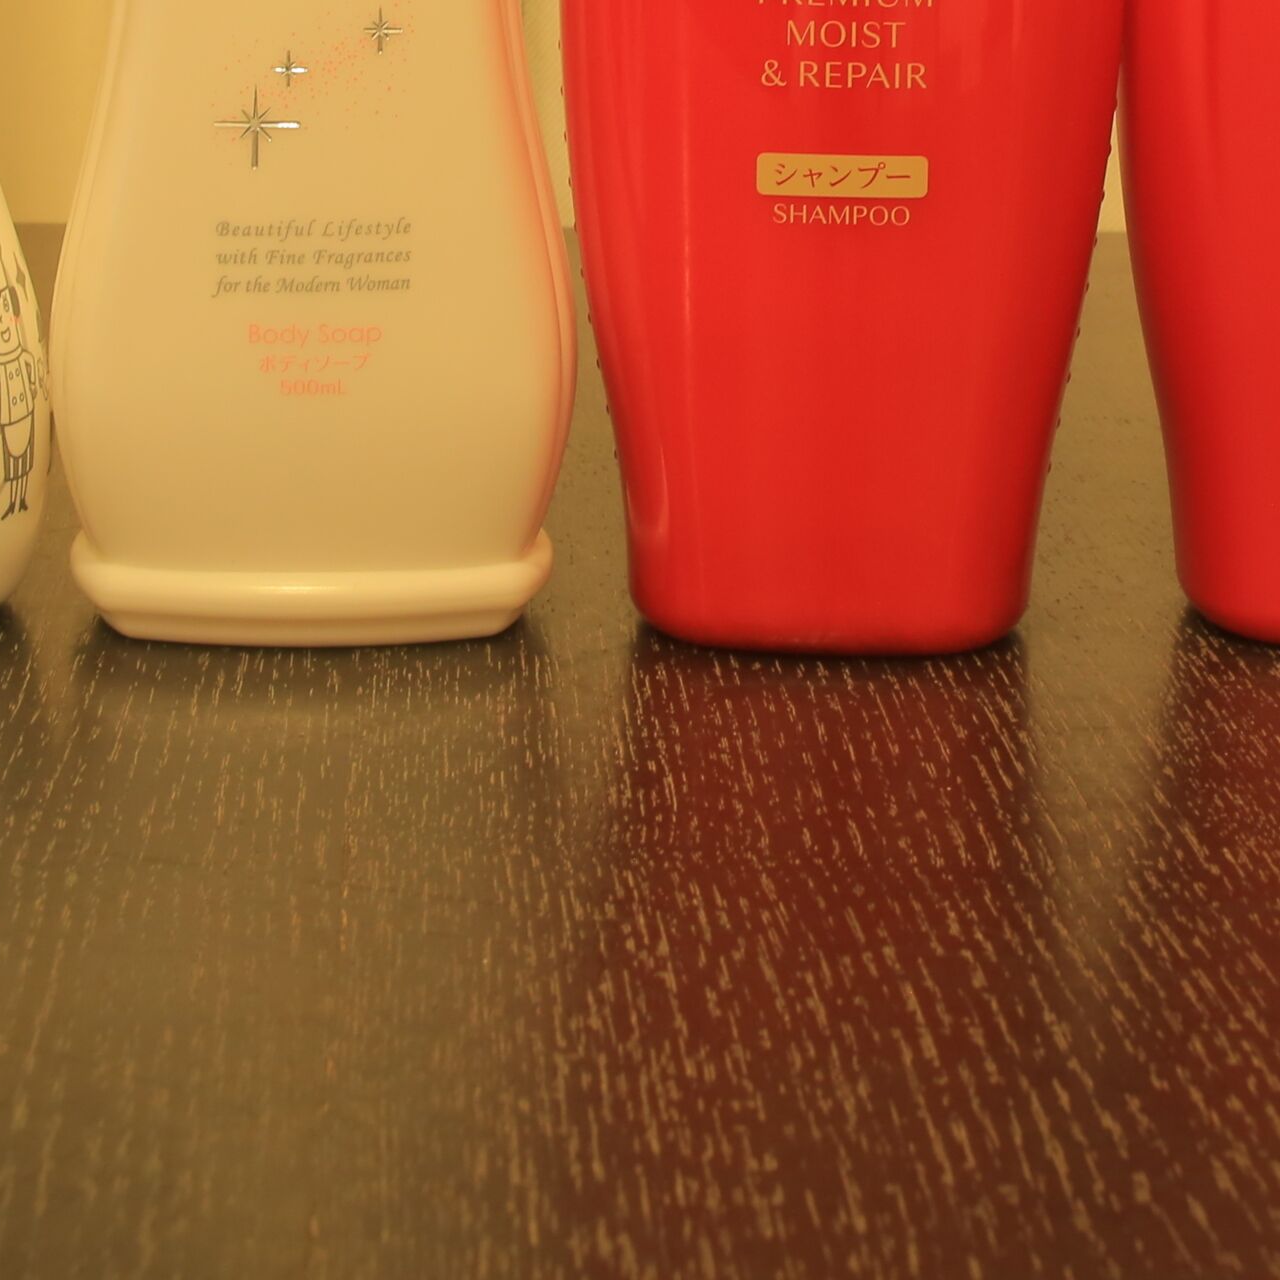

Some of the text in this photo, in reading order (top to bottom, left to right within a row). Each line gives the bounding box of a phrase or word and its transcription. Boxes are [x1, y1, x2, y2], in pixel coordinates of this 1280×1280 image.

[786, 20, 907, 49] MOIST
[760, 59, 928, 89] & REPAIR
[773, 161, 912, 190] シャンプー
[772, 203, 910, 226] SHAMPOO
[215, 217, 412, 242] Beautiful Lifestyle
[215, 248, 412, 269] with Fine Fragrances
[212, 274, 411, 298] for the Modern Woman
[248, 323, 383, 348] Body Soap
